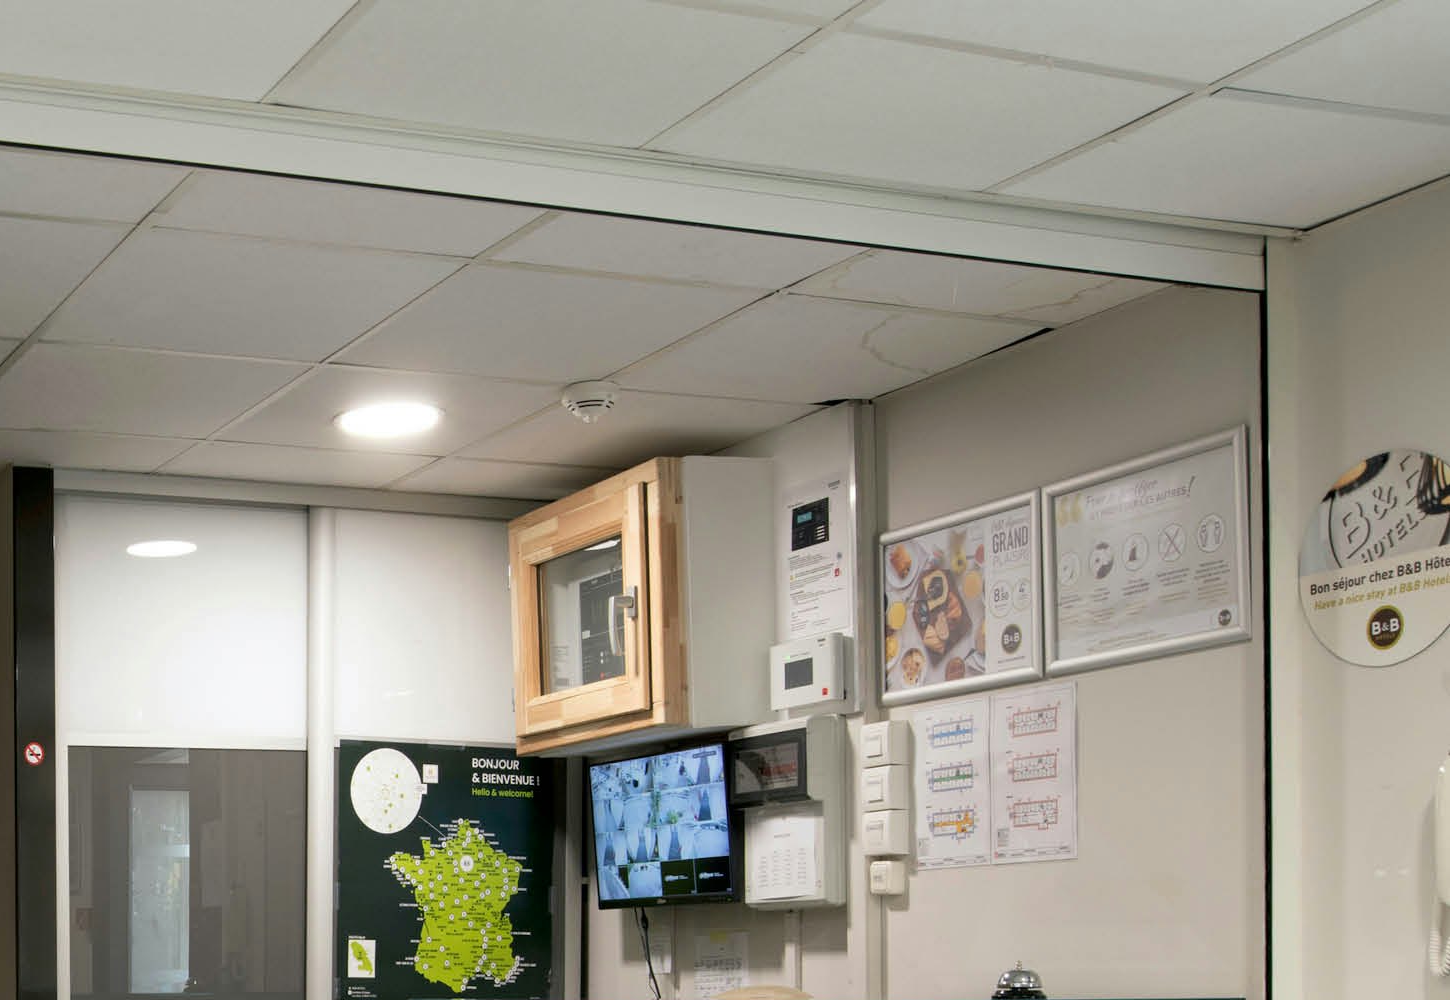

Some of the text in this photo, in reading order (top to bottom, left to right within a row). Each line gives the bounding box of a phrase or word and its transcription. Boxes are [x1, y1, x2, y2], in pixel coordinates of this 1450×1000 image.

[992, 526, 1029, 554] GRAND
[1310, 556, 1450, 596] Bon séjour chez B&B Hôte
[1314, 573, 1450, 609] Have a nice stay at B&B Hotel
[1371, 618, 1400, 636] B&B
[471, 758, 520, 771] BONJOUR
[471, 773, 480, 784] &
[481, 773, 535, 786] BIENVENUE
[471, 788, 534, 798] Hello & welcome!
